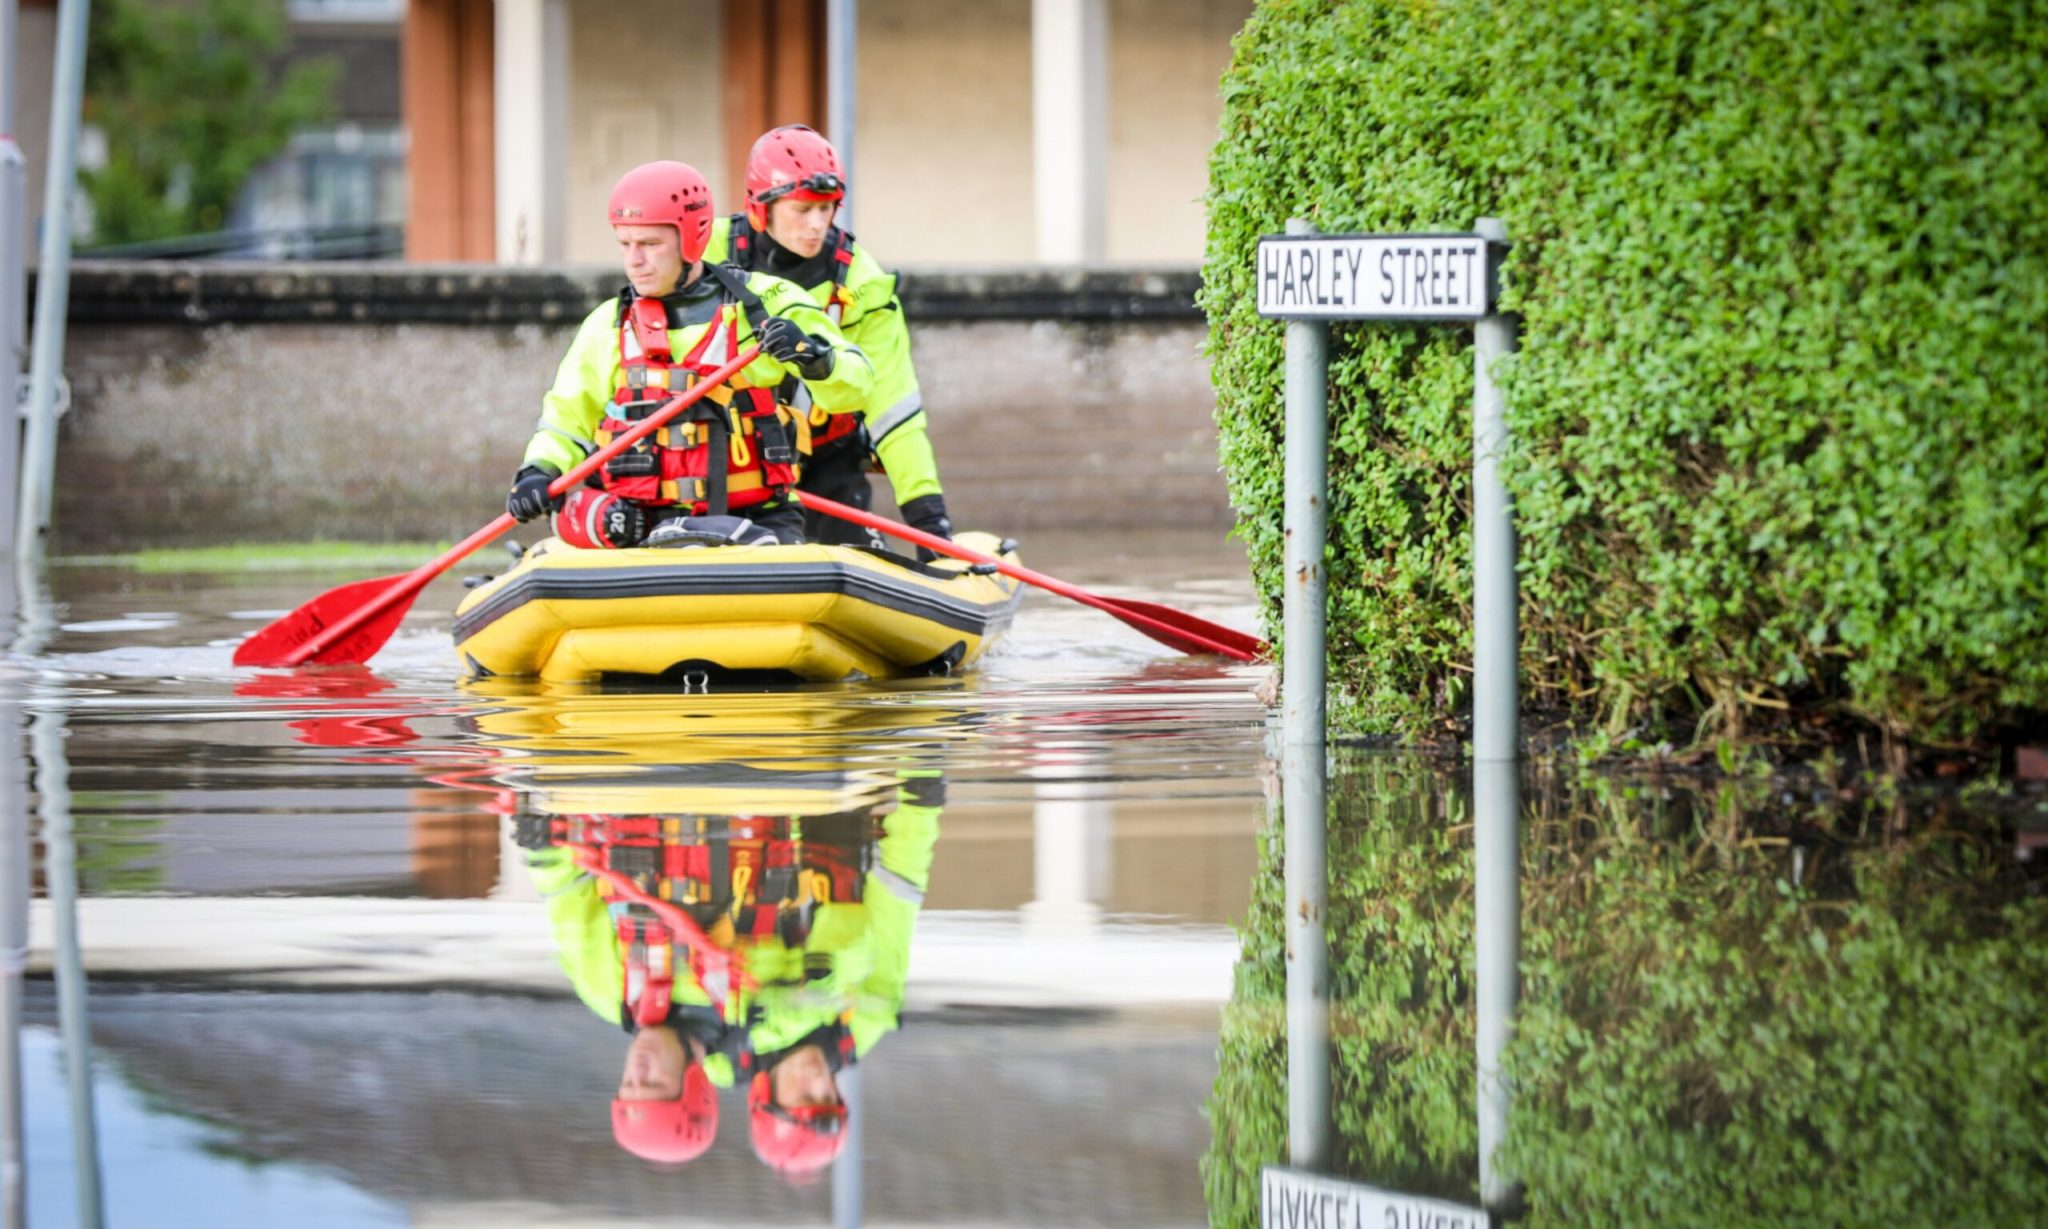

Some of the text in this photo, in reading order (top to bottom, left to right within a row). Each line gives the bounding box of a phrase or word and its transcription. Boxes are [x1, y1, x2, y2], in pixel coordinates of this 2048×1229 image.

[1264, 247, 1477, 305] HARLEY STREET
[610, 512, 626, 534] 20
